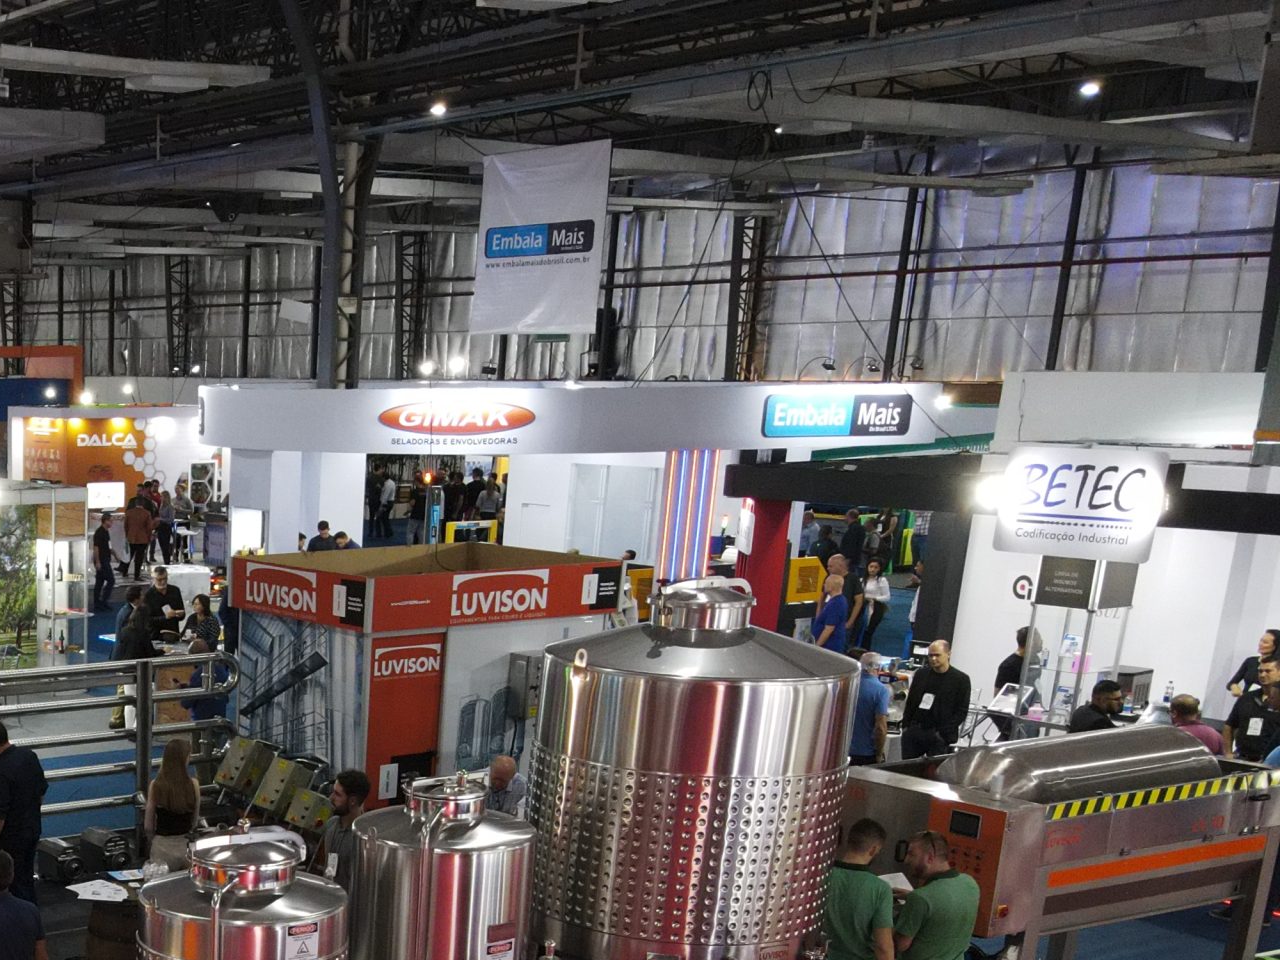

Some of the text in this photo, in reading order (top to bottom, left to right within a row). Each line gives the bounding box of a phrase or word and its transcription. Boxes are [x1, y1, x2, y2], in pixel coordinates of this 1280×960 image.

[492, 227, 585, 251] Embala Mais
[398, 405, 509, 427] GIMAK
[773, 402, 902, 427] Embala Mais
[77, 432, 137, 447] DALCA
[391, 437, 518, 446] SELADORAS E ENVOLVEDORAS
[1021, 463, 1147, 513] BETEC
[1015, 527, 1129, 546] Codificação Industrial
[246, 580, 317, 614] LUVISON
[450, 587, 548, 616] LUVISON
[373, 656, 440, 677] LUVISON
